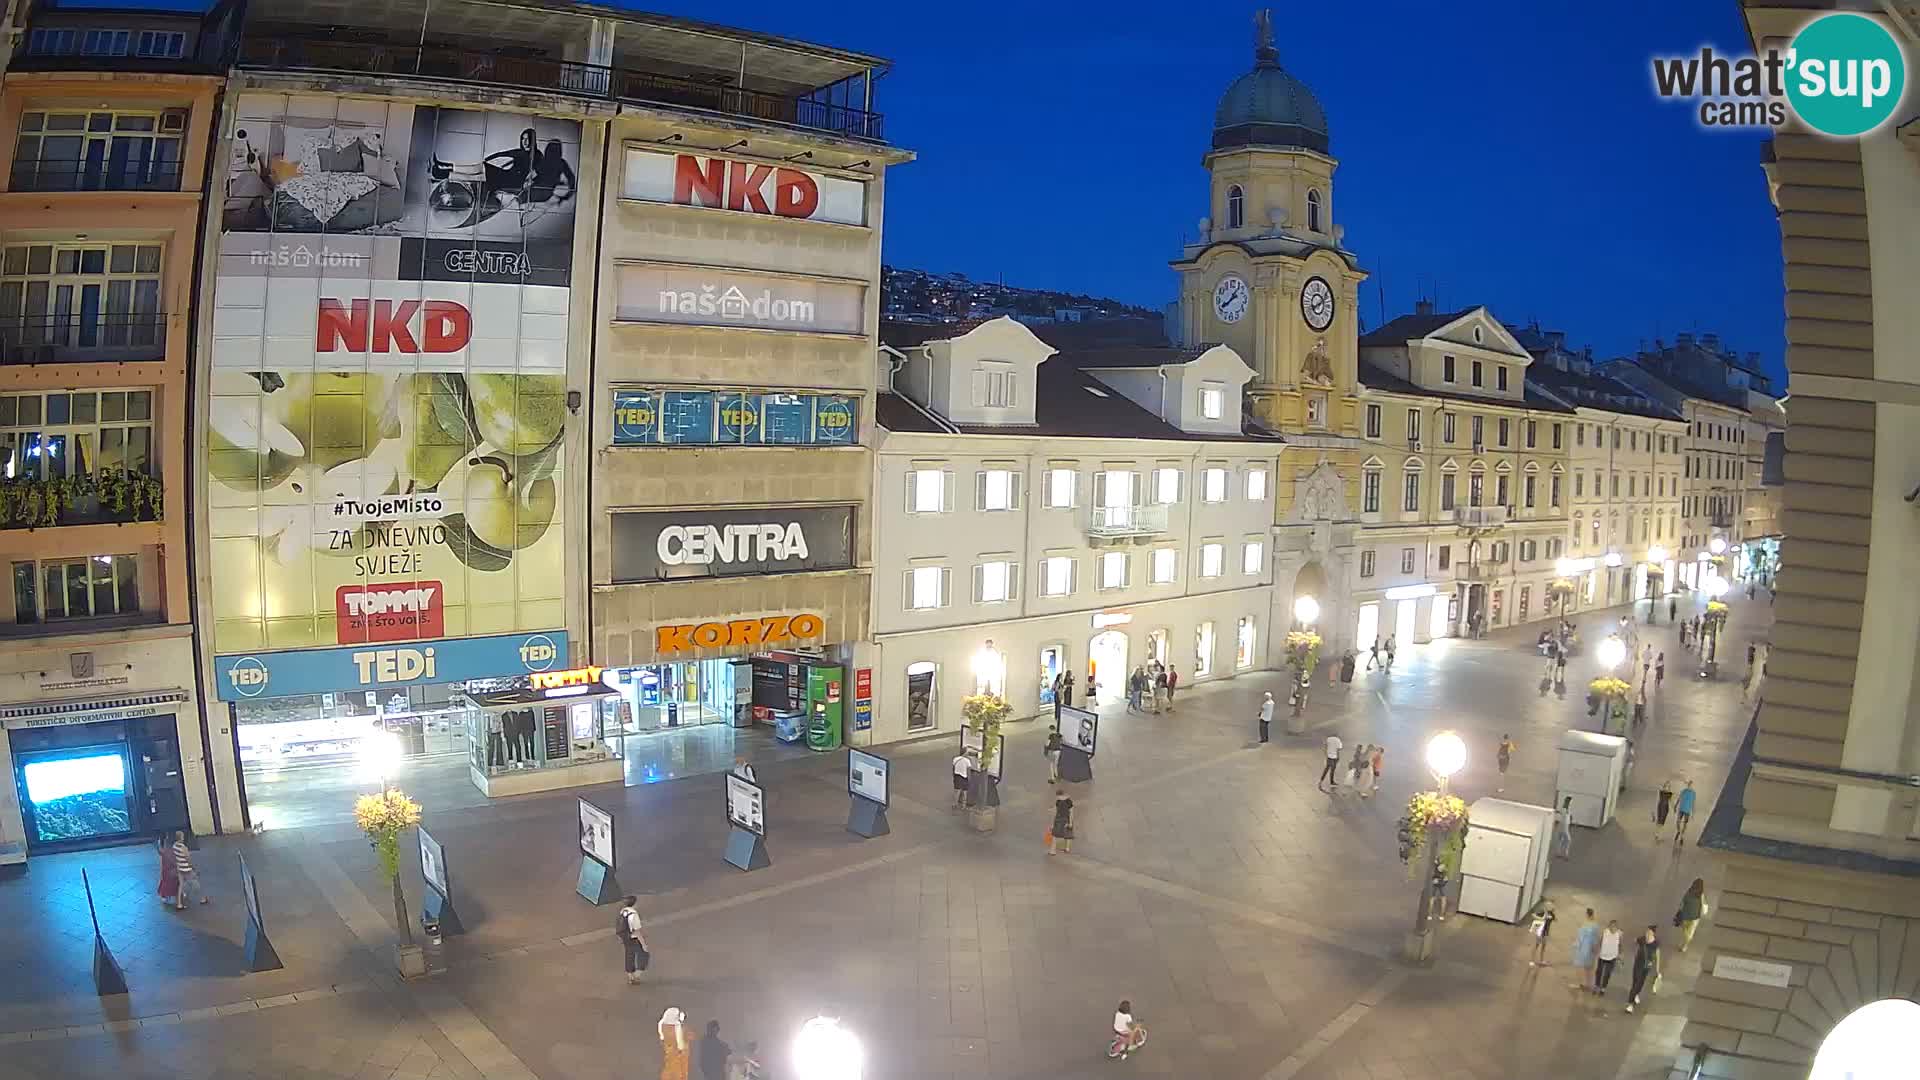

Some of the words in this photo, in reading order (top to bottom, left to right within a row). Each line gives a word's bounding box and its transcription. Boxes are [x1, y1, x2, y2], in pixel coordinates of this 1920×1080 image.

[672, 154, 819, 220] NKD
[250, 245, 289, 267] naš
[314, 245, 361, 269] dom
[444, 248, 532, 276] CENTRA
[659, 281, 717, 315] naš
[754, 288, 816, 323] dom
[316, 297, 473, 354] NKD
[615, 408, 656, 426] TEDi
[817, 411, 851, 428] TEDi
[334, 497, 443, 518] #TvojeMisto
[329, 529, 353, 550] ZA
[365, 525, 447, 549] DNEVNO
[657, 521, 809, 566] CENTRA
[355, 549, 423, 577] SVJEŽE
[344, 588, 436, 616] TOMMY
[375, 616, 396, 628] ŠTO
[655, 612, 825, 655] KORZO
[353, 647, 437, 685] TEDi
[519, 644, 557, 663] TEDi
[228, 667, 269, 686] TEDi
[530, 665, 602, 690] TOMMY
